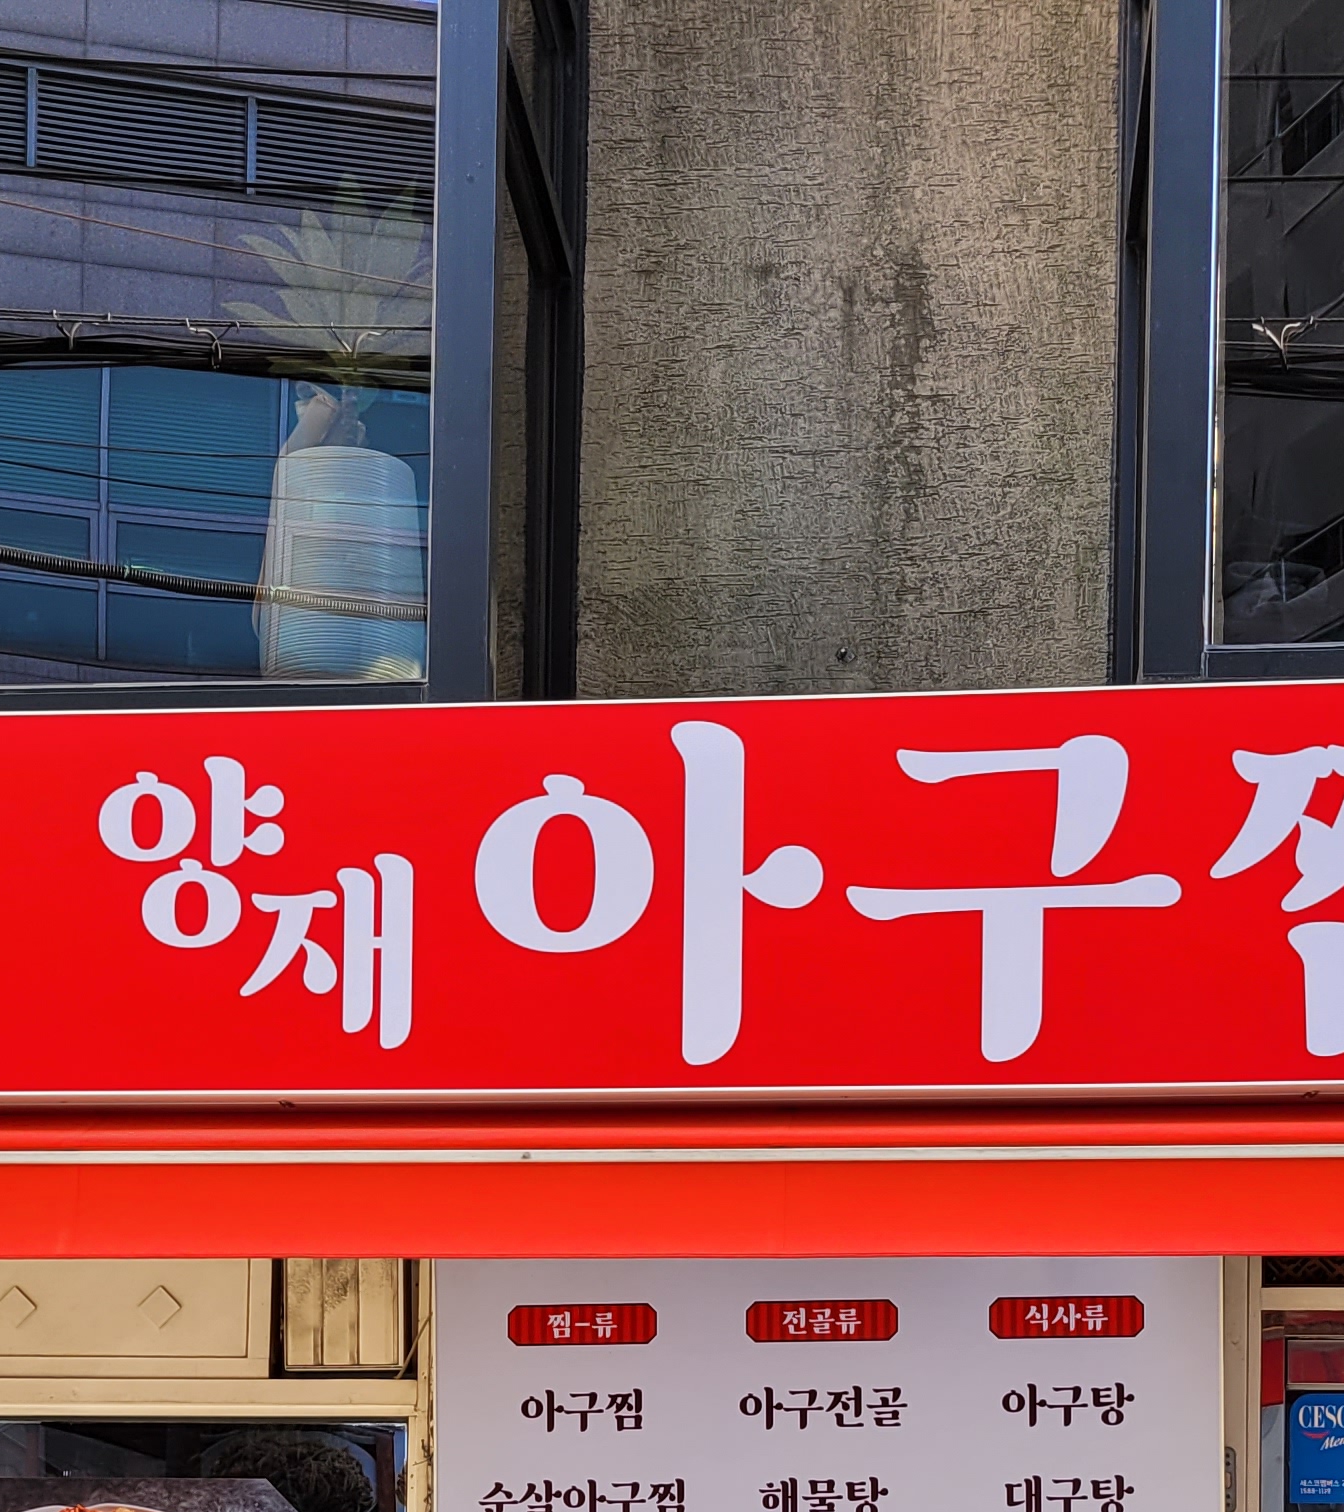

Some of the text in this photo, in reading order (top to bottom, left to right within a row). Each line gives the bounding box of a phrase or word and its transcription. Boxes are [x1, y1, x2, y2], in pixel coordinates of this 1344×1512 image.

[98, 755, 414, 1050] 양재
[782, 1307, 862, 1335] 전골류
[1024, 1302, 1109, 1332] 식사류
[520, 1388, 643, 1433] 아구찜
[739, 1385, 908, 1431] 아구전골
[1001, 1382, 1135, 1428] 아구탕
